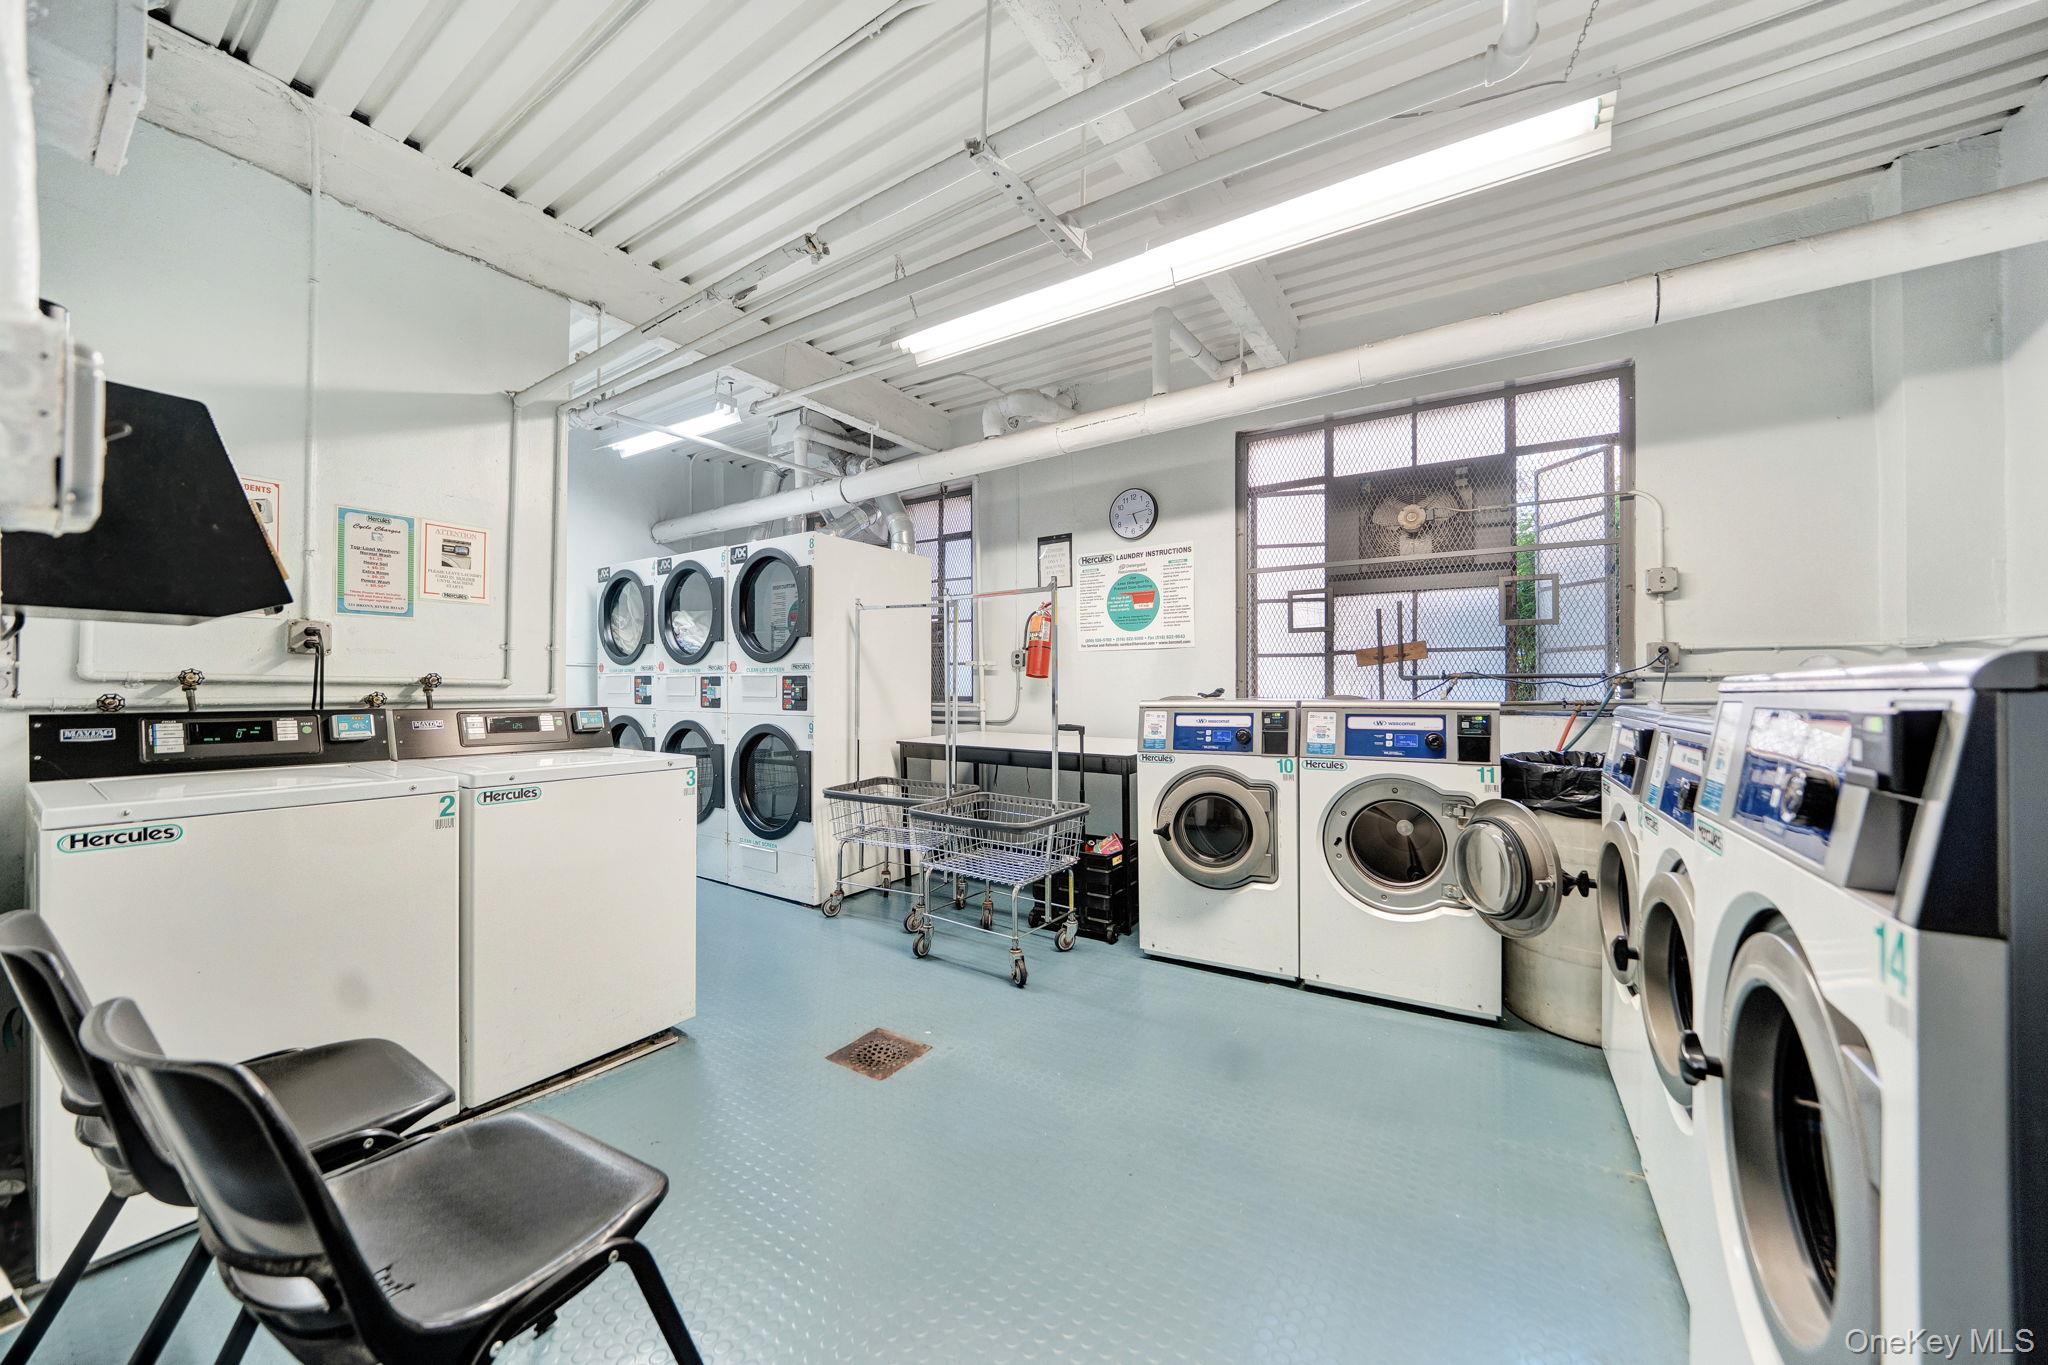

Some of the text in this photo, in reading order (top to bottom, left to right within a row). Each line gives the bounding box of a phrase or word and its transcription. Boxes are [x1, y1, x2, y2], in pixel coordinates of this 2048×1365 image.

[1130, 493, 1137, 501] 12
[1145, 500, 1150, 508] 2
[1147, 508, 1153, 516] 3
[367, 515, 391, 525] Hercules
[352, 522, 401, 535] Cycle Charges
[435, 528, 478, 540] ATTENTION
[1124, 526, 1129, 534] 7
[1131, 527, 1136, 535] 6
[808, 538, 815, 549] 8
[720, 552, 726, 563] 6
[1081, 546, 1192, 565] Hercules LAUNDRY INSTRUCTIONS
[64, 729, 113, 738] MAYTAG
[808, 722, 814, 734] 9
[1141, 754, 1173, 763] Hercules
[1276, 758, 1294, 774] 10
[1305, 760, 1345, 770] Hercules
[686, 769, 696, 786] 3
[1476, 767, 1495, 784] 11
[483, 788, 538, 803] Hercules
[439, 795, 456, 817] 2
[69, 826, 177, 851] Hercules
[1875, 920, 1909, 998] 14
